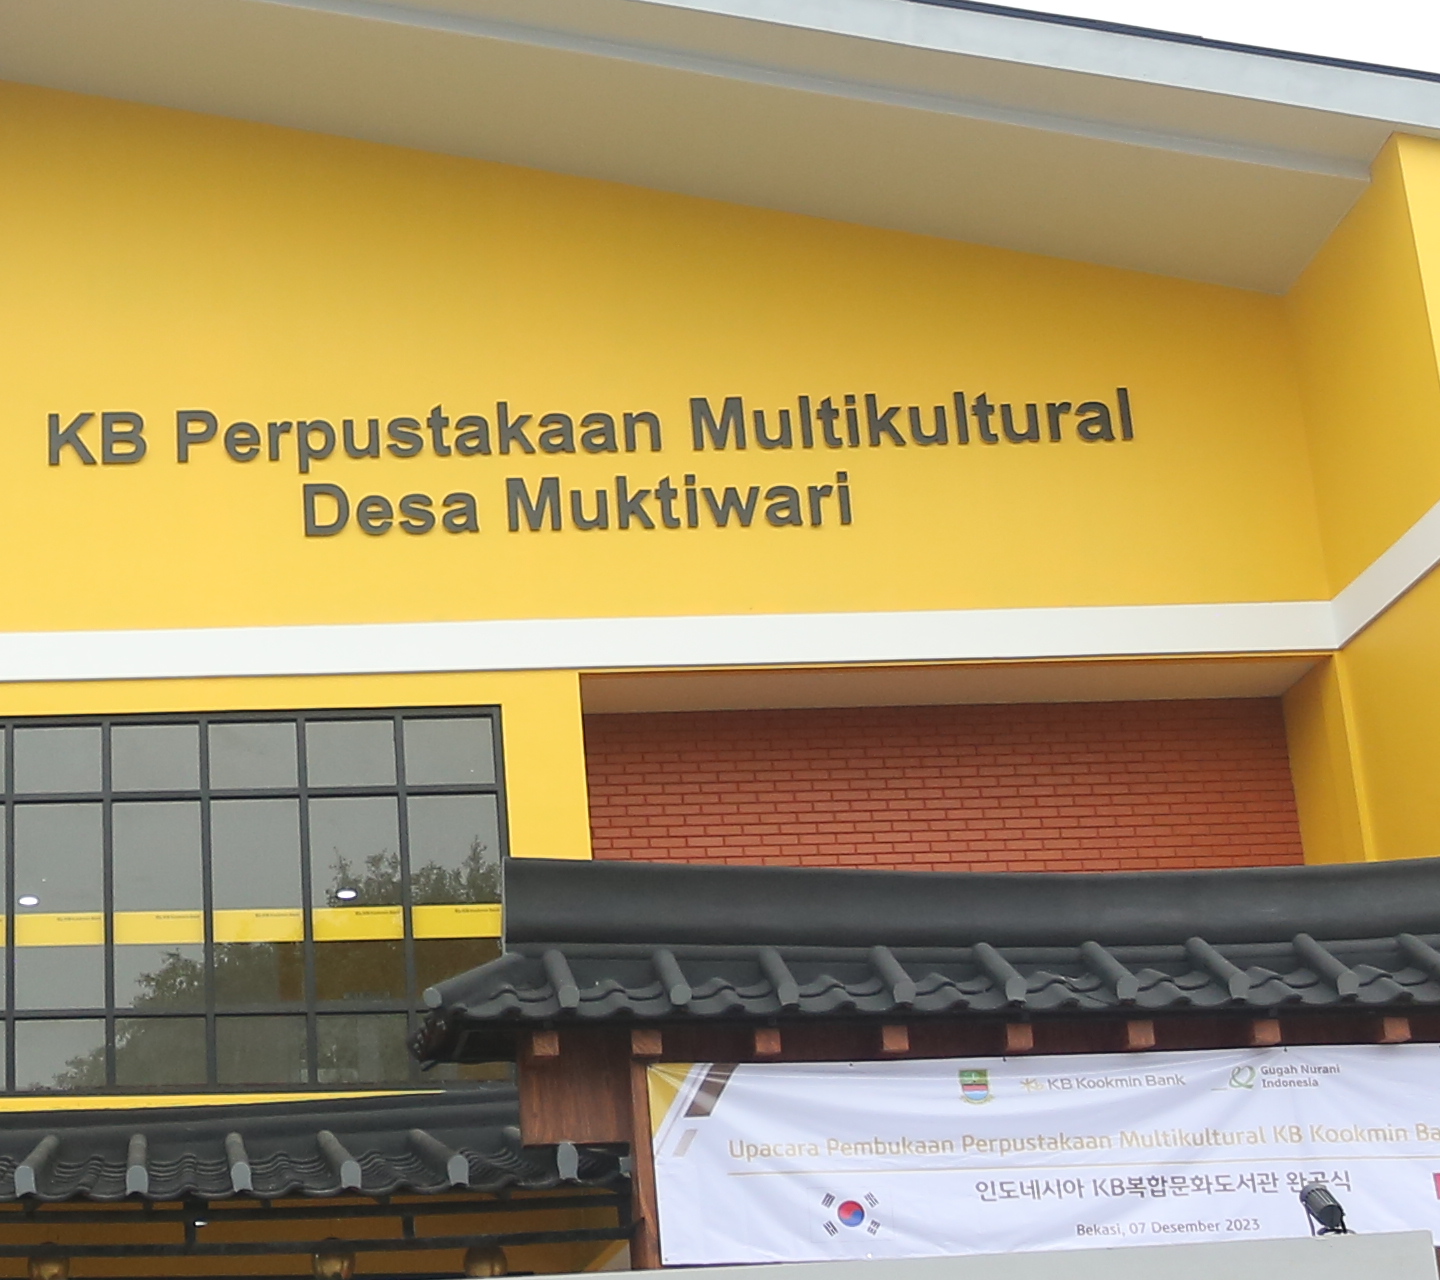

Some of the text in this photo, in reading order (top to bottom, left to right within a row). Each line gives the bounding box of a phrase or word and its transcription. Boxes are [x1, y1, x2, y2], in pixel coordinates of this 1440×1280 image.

[48, 387, 1134, 474] KB Perpustakaan Multikultural
[301, 470, 853, 538] Desa Muktiwari
[1047, 1073, 1187, 1091] KB Kookmin Bank
[1260, 1063, 1341, 1077] Gugah Nurani
[1261, 1077, 1320, 1089] Indonesia
[728, 1139, 819, 1162] Upacara
[826, 1135, 955, 1157] Pembukaan
[961, 1131, 1112, 1158] Perpustakaan
[1119, 1127, 1266, 1149] Multikultural
[1273, 1126, 1304, 1144] KB
[1310, 1124, 1409, 1144] Kookmin
[975, 1177, 1085, 1202] 인도네시아
[1092, 1171, 1281, 1199] KB복합문화도서관
[1076, 1218, 1261, 1238] Bekasi, 07 Desember 2023
